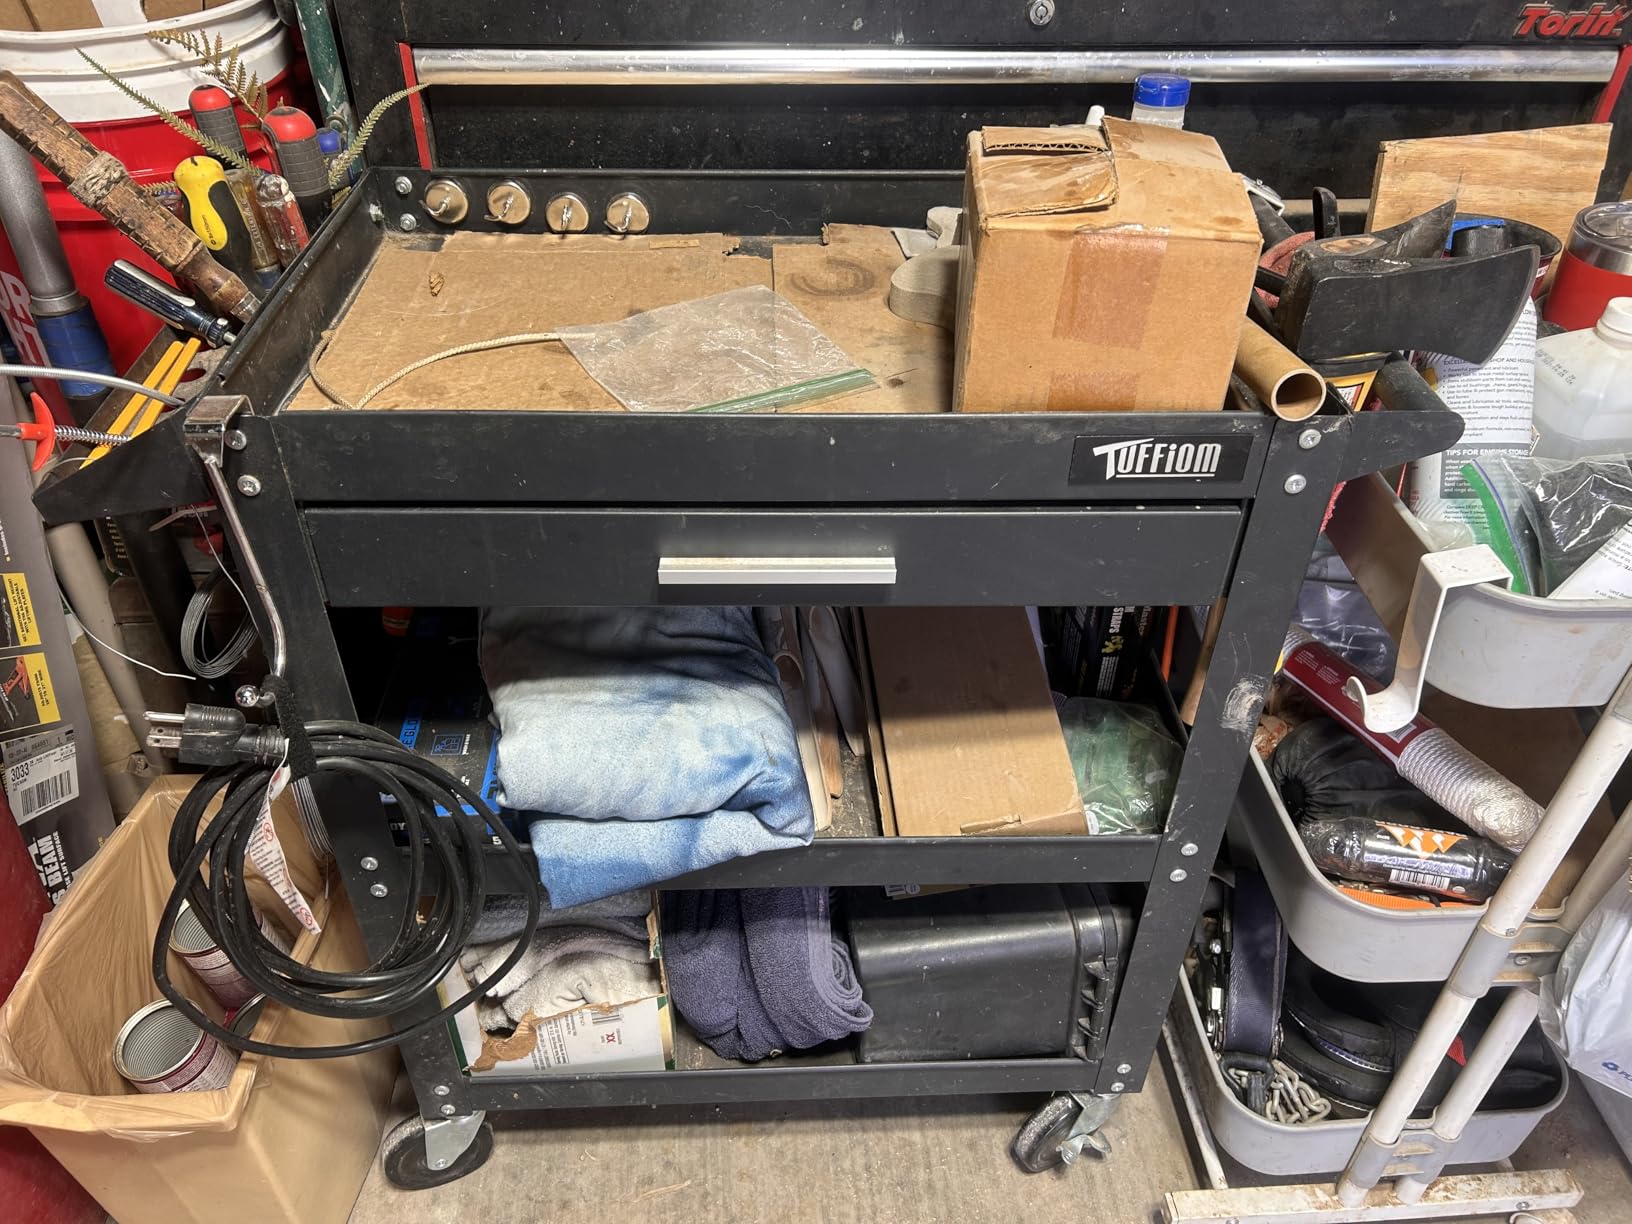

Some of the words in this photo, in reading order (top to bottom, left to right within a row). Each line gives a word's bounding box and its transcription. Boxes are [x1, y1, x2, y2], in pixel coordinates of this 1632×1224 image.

[1516, 4, 1625, 37] Torin
[1109, 607, 1124, 634] STRAPS
[10, 762, 30, 782] 3033
[52, 830, 66, 862] SURFACE
[37, 834, 64, 888] BEAM
[60, 861, 72, 877] LIFT
